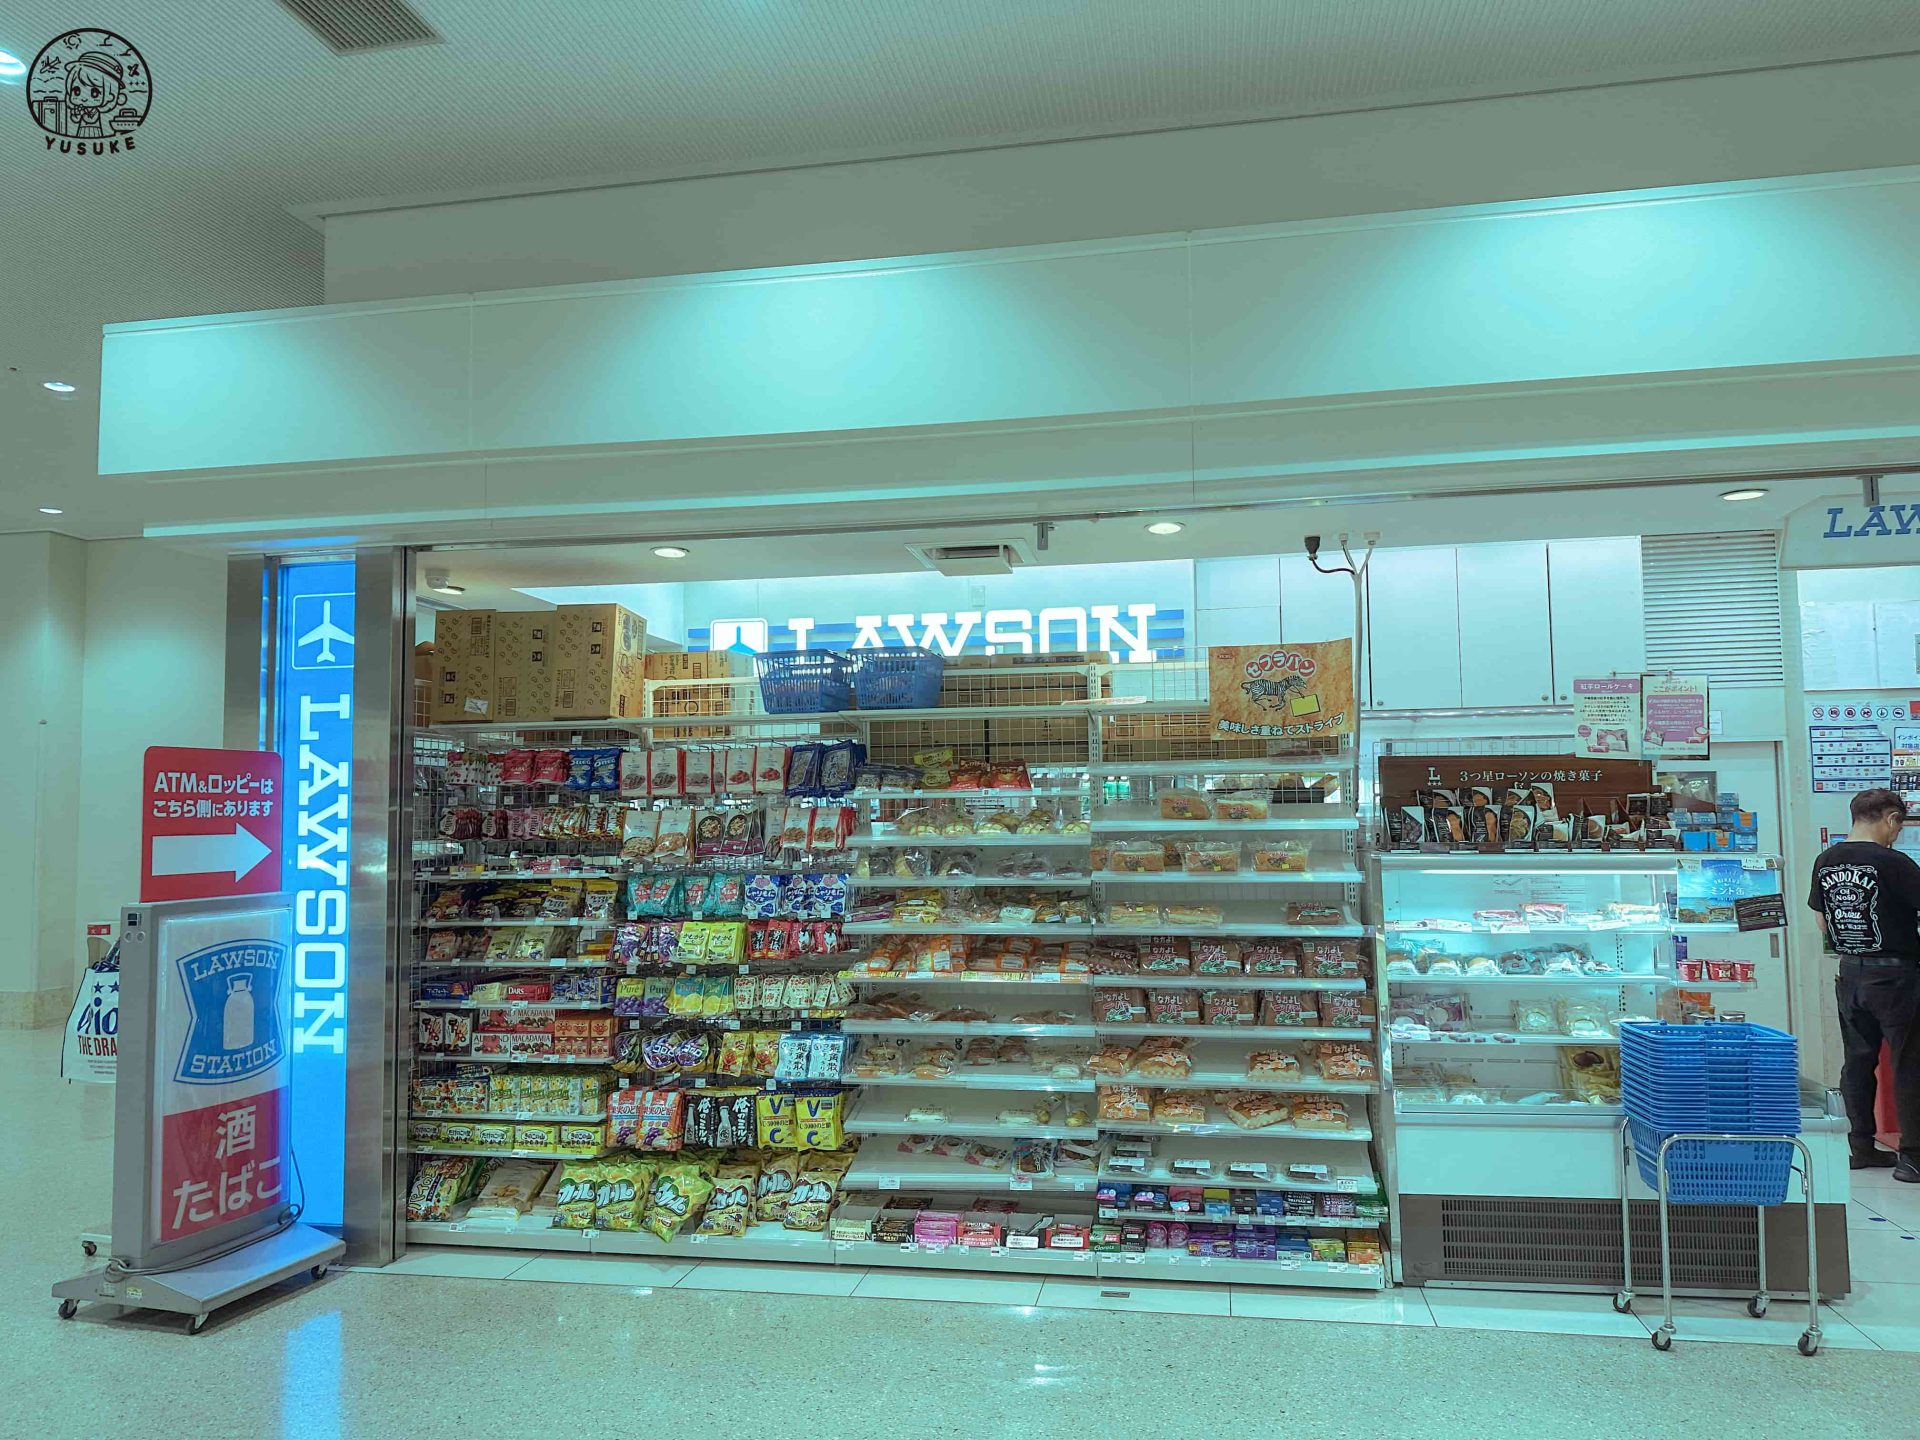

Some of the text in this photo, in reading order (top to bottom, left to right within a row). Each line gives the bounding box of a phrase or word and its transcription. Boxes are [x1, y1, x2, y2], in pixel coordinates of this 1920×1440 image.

[153, 771, 274, 795] ATM&ロッピーは
[1460, 769, 1603, 782] 3つ星ローソンの焼き菓子
[153, 798, 274, 818] こちら側にあります
[294, 693, 350, 1054] LAWSON
[1710, 887, 1745, 896] ミント缶
[1317, 946, 1343, 954] なかよし
[191, 949, 280, 982] LAWSON
[508, 986, 525, 994] DARS
[1157, 995, 1183, 1004] なかよし
[1213, 998, 1238, 1006] なかよし
[517, 1009, 554, 1017] MACADAMIA
[78, 1035, 94, 1055] THE
[512, 1034, 551, 1042] MACADAMIA
[191, 1038, 277, 1075] STATION
[769, 1096, 784, 1115] V
[807, 1099, 821, 1118] V
[215, 1105, 256, 1159] 酒
[480, 1132, 505, 1140] たけのこの里
[524, 1132, 548, 1140] きのこの山
[568, 1132, 593, 1141] きのこの山
[769, 1127, 784, 1143] C
[807, 1131, 821, 1146] C
[172, 1156, 282, 1230] たばこ
[596, 1182, 636, 1208] カール
[789, 1182, 832, 1206] カール
